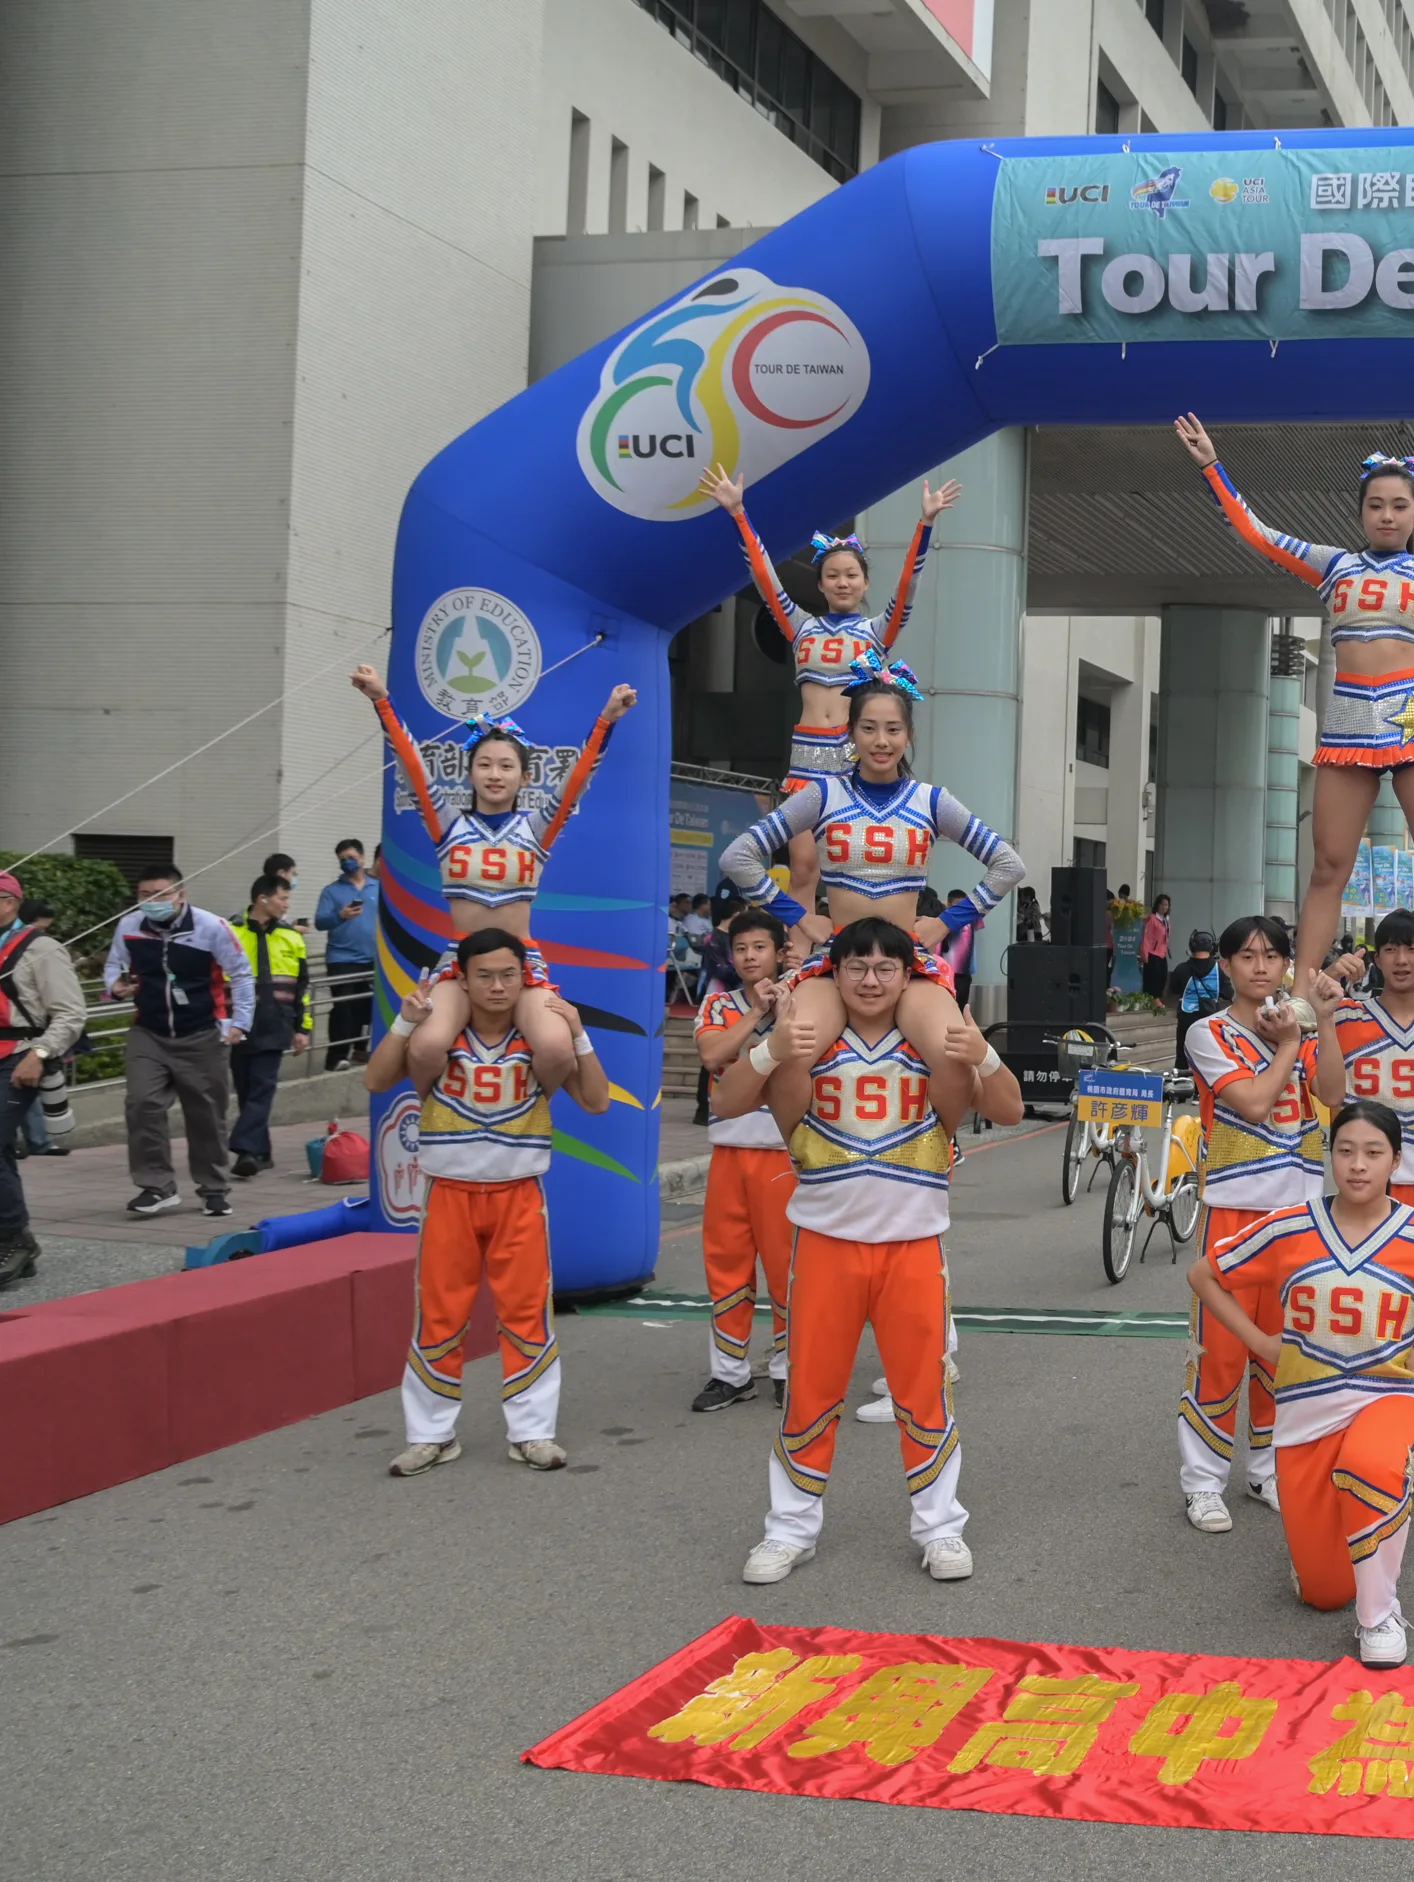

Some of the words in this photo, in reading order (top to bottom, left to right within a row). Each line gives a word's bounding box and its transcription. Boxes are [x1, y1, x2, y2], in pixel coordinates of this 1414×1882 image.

[1058, 184, 1109, 204] UCI
[1242, 186, 1265, 194] ASIA
[1243, 178, 1264, 186] UCI
[1130, 201, 1150, 209] TOUR
[1243, 195, 1269, 203] TOUR
[1038, 236, 1274, 315] Tour
[754, 364, 783, 375] TOUR
[786, 364, 801, 375] DE
[802, 364, 844, 375] TAIWAN
[632, 434, 695, 459] UCI
[420, 604, 450, 688] MINISTRY
[452, 595, 474, 612] OF
[479, 597, 533, 695] EDUCATION
[435, 688, 510, 716] 教育部
[824, 822, 932, 867] SSH
[447, 843, 538, 885] SSH
[442, 1062, 531, 1103] SSH
[1023, 1070, 1073, 1083] 請勿停
[813, 1074, 929, 1123] SSH
[1289, 1284, 1411, 1342] SSH
